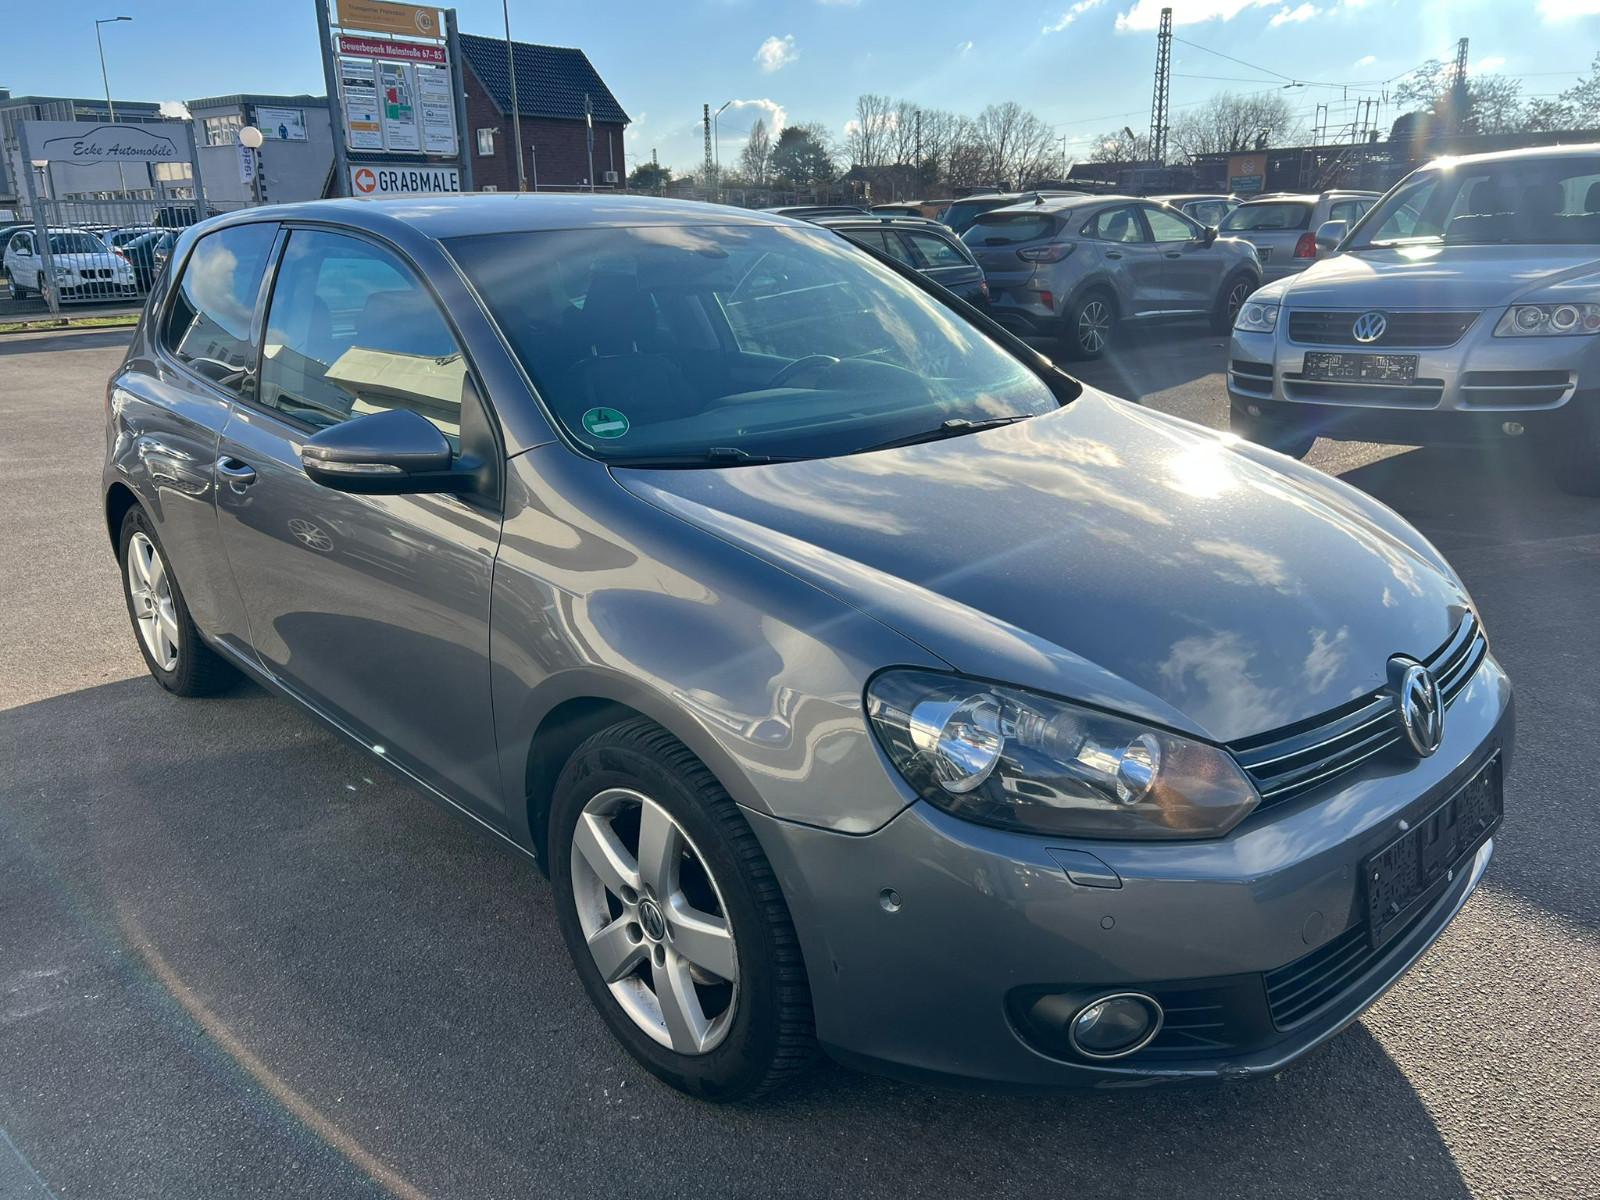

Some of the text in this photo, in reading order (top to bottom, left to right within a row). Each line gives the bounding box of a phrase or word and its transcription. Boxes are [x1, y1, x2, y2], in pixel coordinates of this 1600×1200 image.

[341, 41, 385, 54] Gewerbepark
[386, 45, 421, 57] Mainstraße
[72, 141, 173, 157] Ecke Automobile
[379, 171, 458, 192] GRABMALE
[1352, 312, 1387, 342] VW
[1401, 664, 1444, 757] VW
